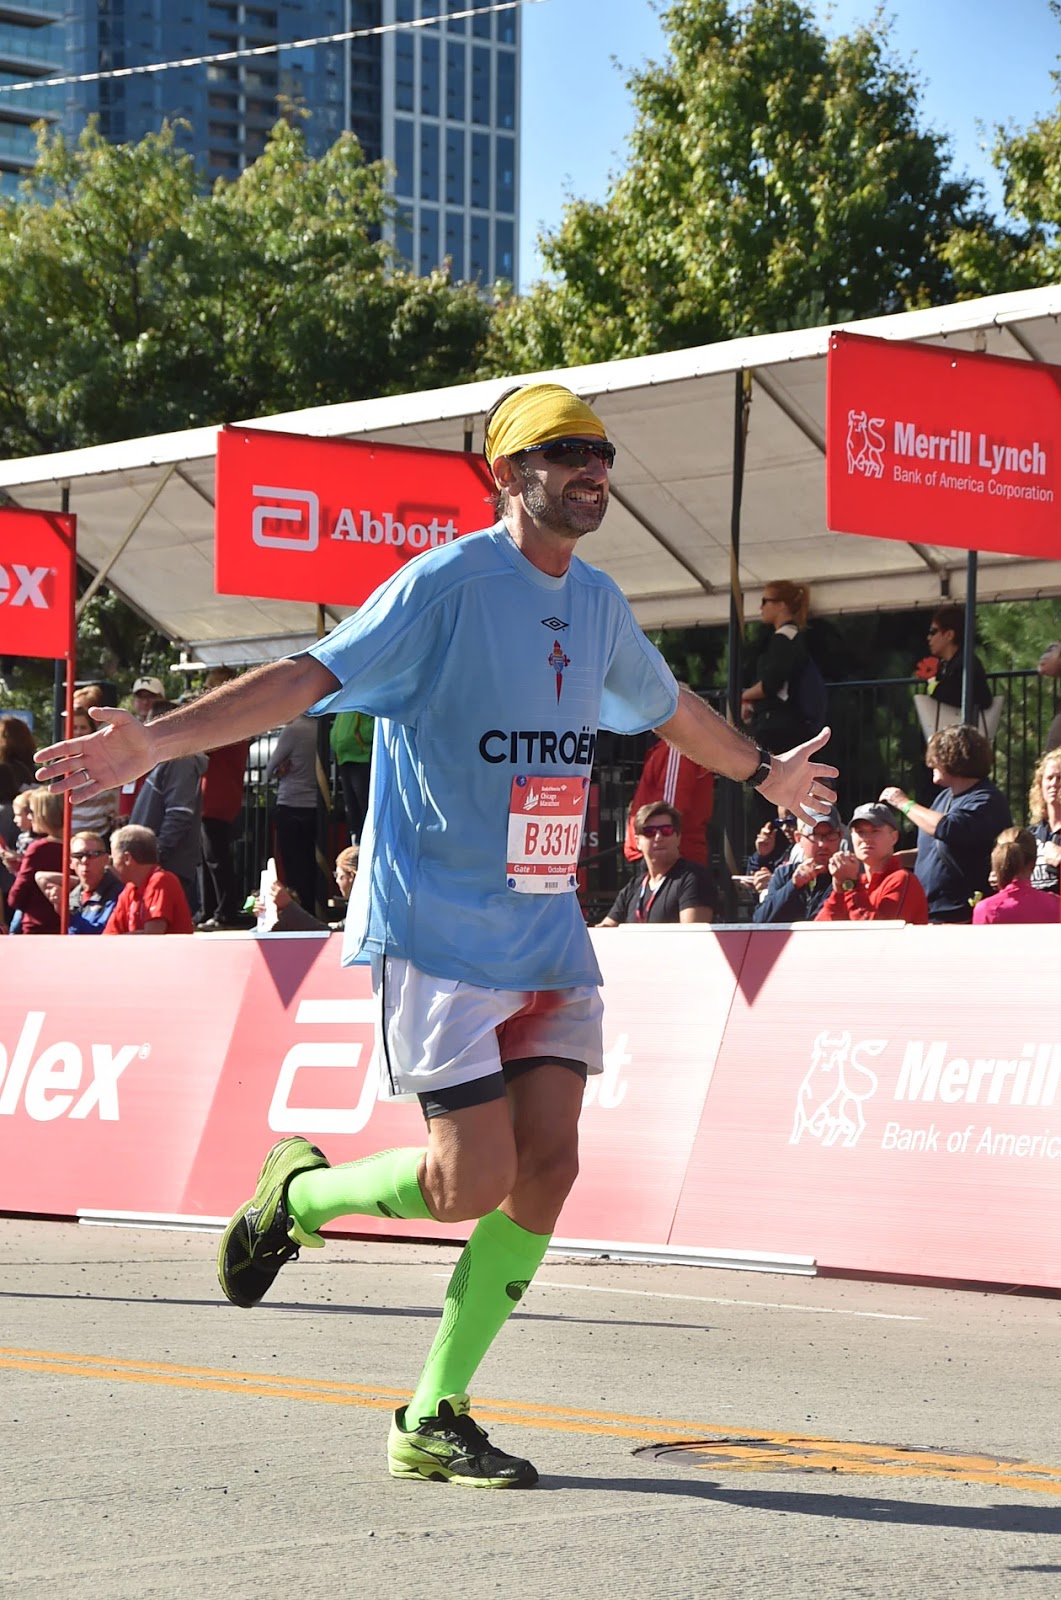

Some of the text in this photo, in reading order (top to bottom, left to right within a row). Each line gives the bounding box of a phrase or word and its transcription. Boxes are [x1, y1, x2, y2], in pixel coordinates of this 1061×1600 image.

[893, 421, 1046, 476] Merrill Lynch
[893, 465, 1054, 502] Bank of America Corporation
[330, 508, 458, 548] Abbott
[513, 864, 531, 873] Gate
[547, 865, 568, 874] October
[894, 1040, 1061, 1106] Merrill
[881, 1121, 1061, 1160] Bank of Americ
